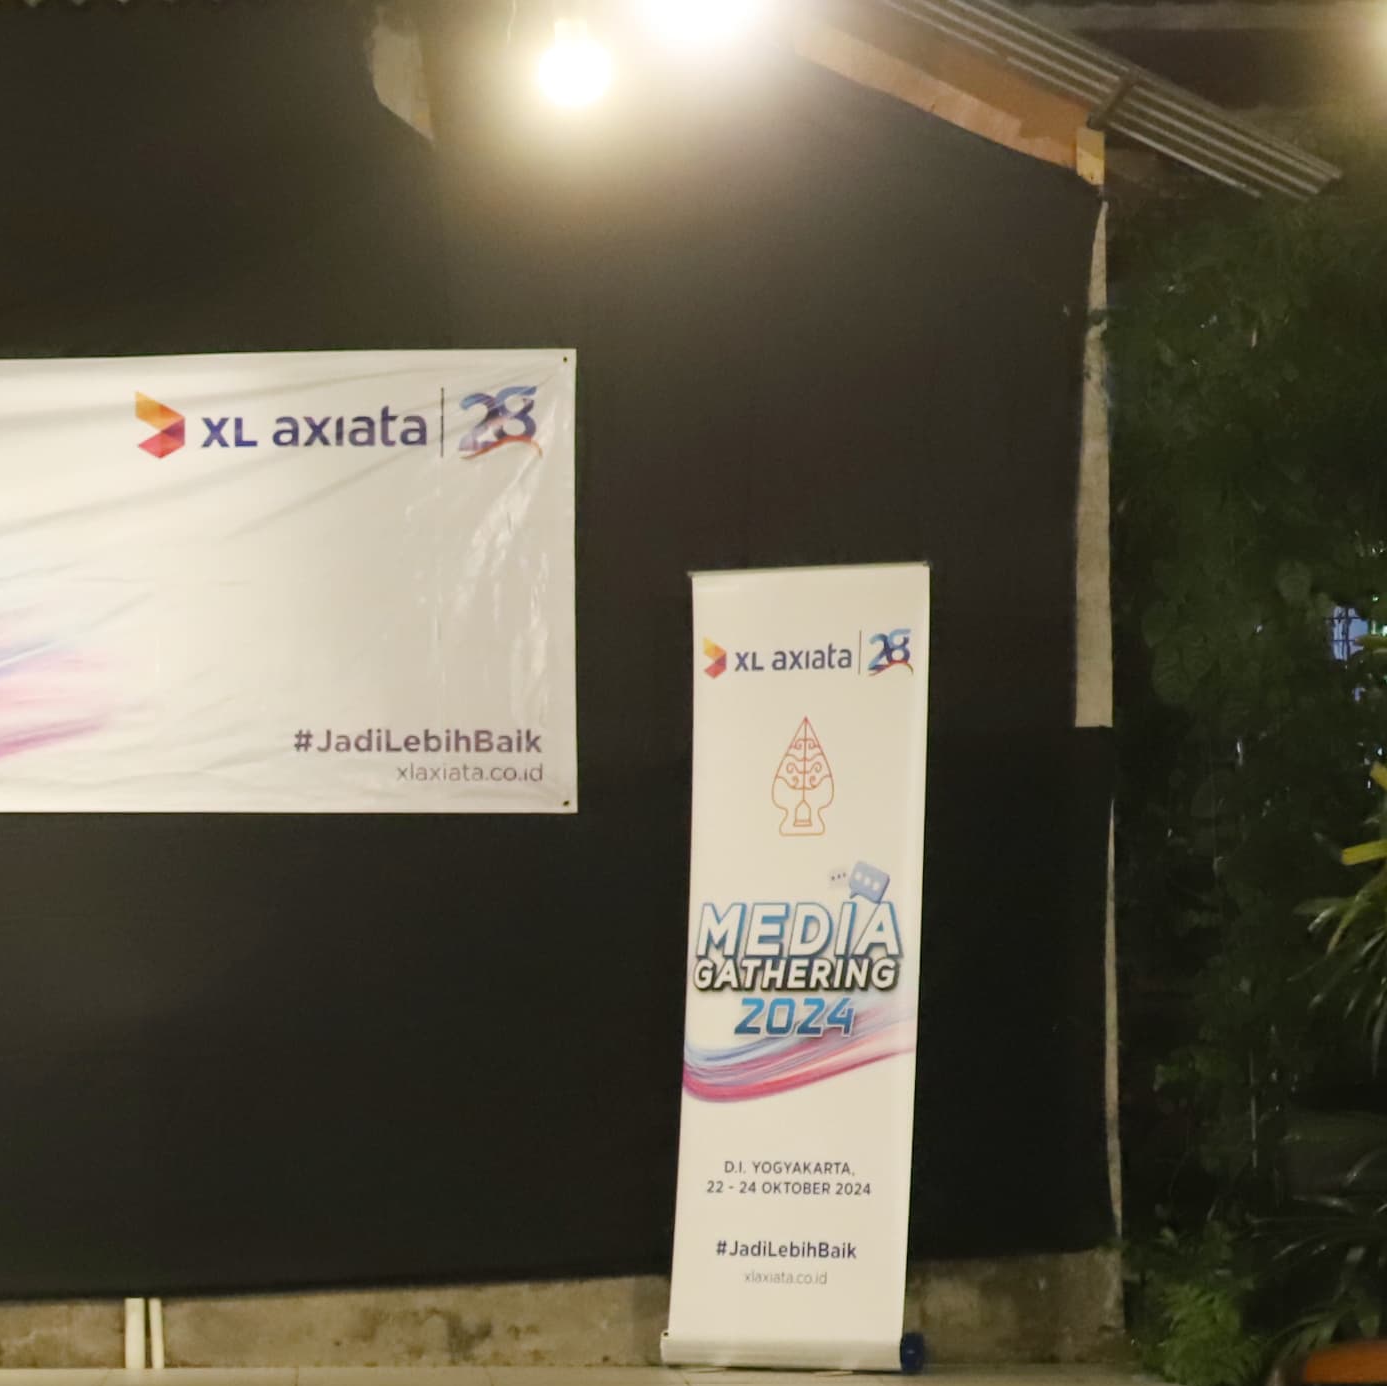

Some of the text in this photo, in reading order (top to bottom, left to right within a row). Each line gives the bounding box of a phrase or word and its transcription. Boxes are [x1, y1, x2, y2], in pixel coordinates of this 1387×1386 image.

[201, 416, 258, 448] XL
[272, 405, 427, 448] axiata
[734, 651, 765, 672] XL
[771, 642, 853, 671] axiata
[293, 728, 543, 753] #JadiLebihBaik
[396, 762, 544, 782] xlaxiata.co.id
[695, 901, 903, 959] MEDIA
[693, 957, 899, 992] GATHERING
[733, 997, 856, 1037] 2024
[723, 1160, 856, 1176] D.I. YOGYAKARTA,
[706, 1180, 725, 1194] 22
[739, 1181, 757, 1195] 24
[761, 1181, 831, 1196] OKTOBER
[834, 1182, 872, 1196] 2024
[715, 1240, 857, 1260] #JadiLebihBaik
[743, 1271, 828, 1286] xlaxiata.co.id
